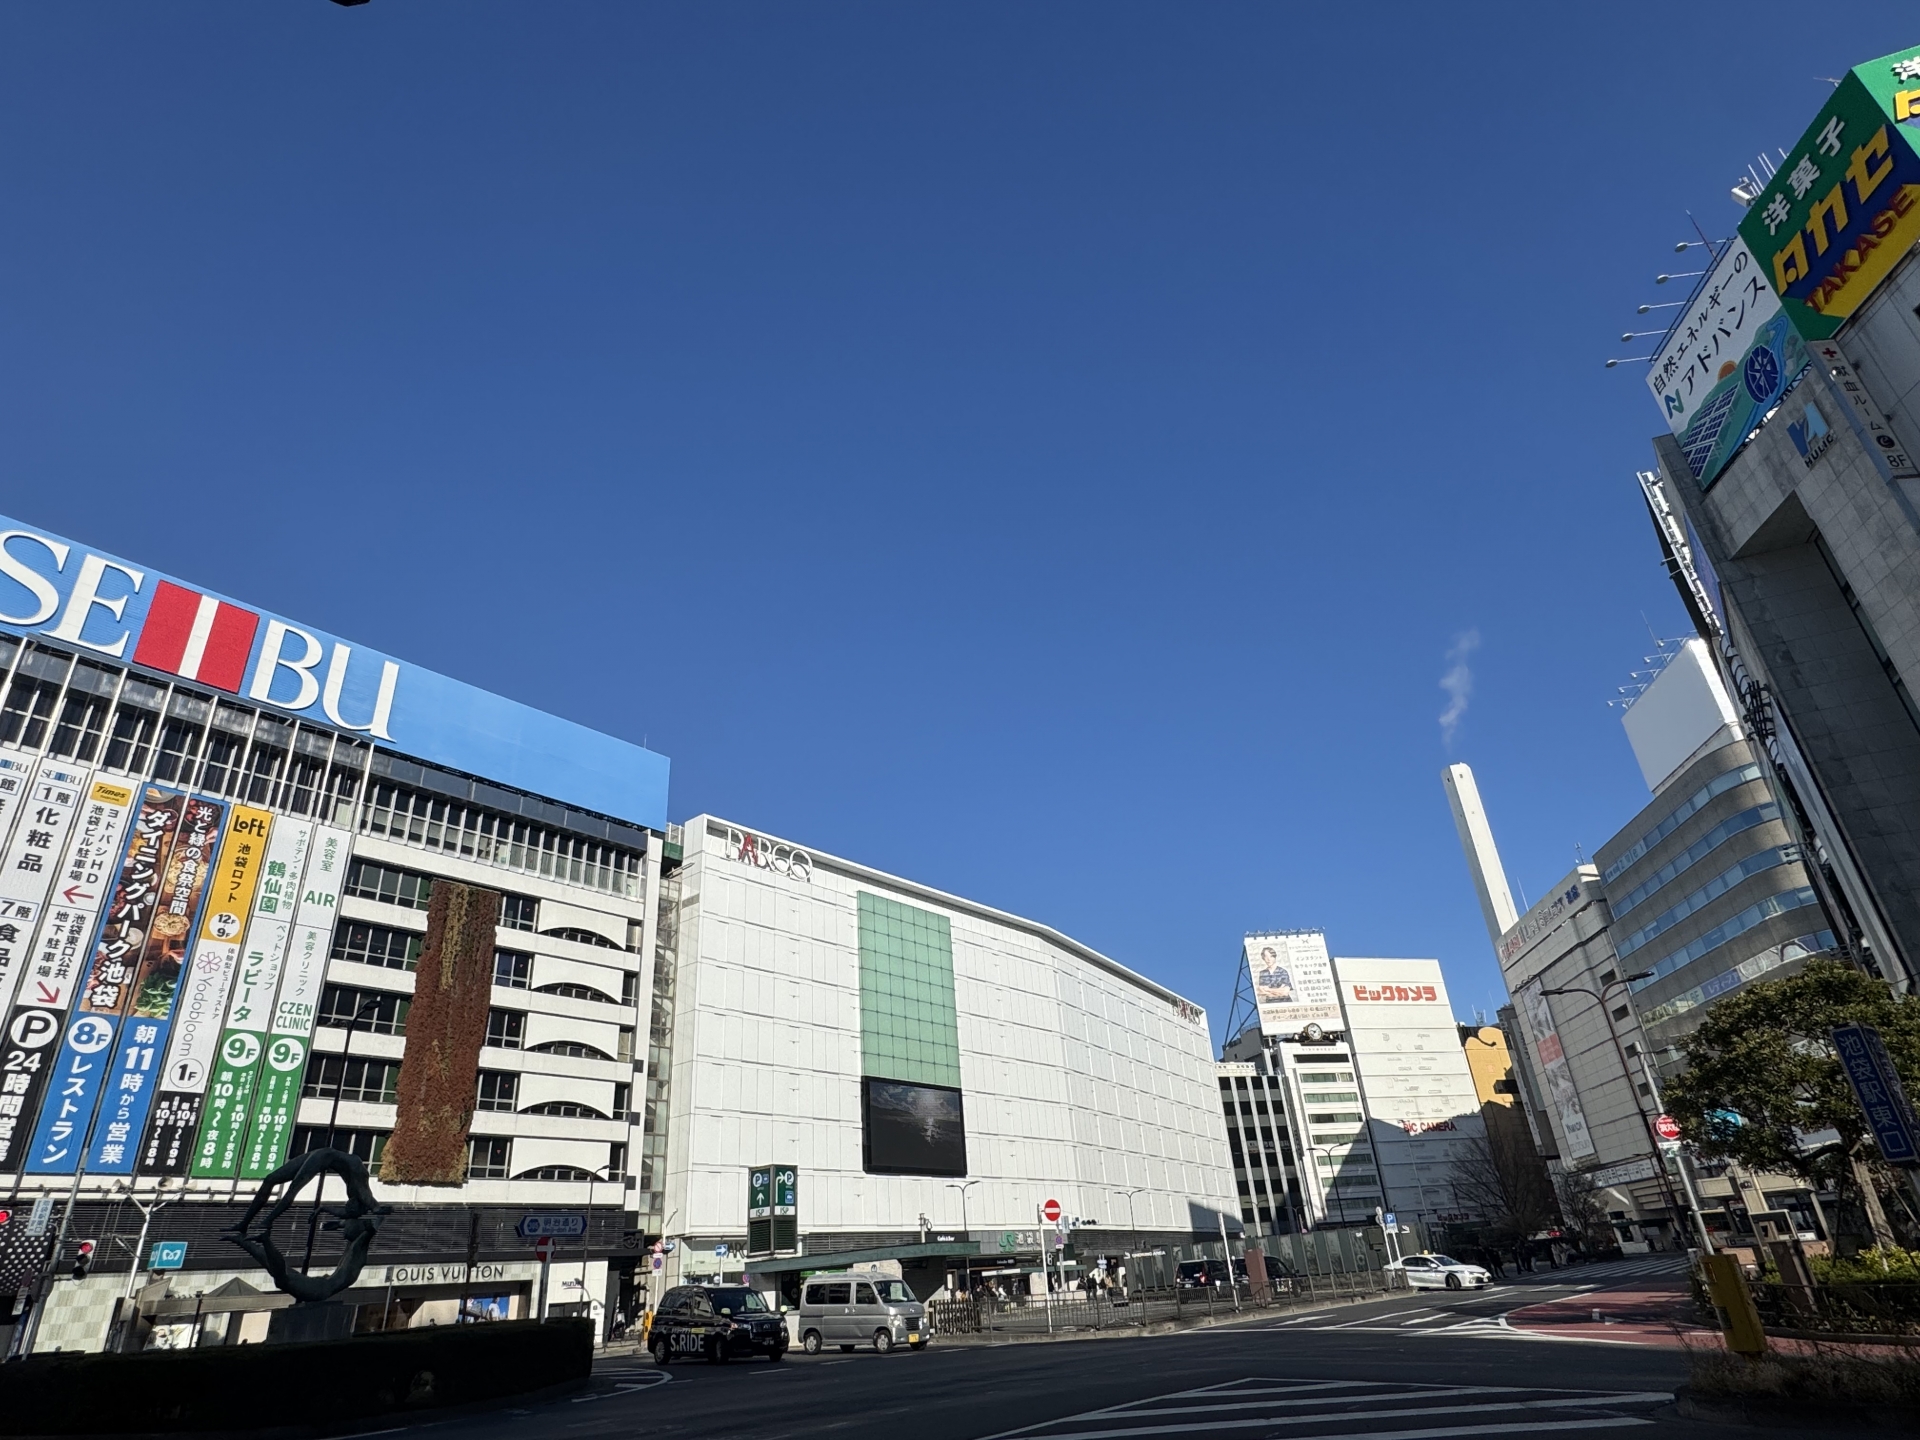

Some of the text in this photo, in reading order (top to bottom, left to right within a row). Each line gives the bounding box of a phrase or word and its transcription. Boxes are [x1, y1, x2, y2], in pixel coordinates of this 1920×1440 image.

[1762, 115, 1845, 236] 洋菓子
[1772, 123, 1894, 296] タカセ
[1805, 184, 1918, 313] TAKASE
[1653, 251, 1748, 396] 自然エネルギーの
[1681, 276, 1767, 395] アドバンス
[1832, 365, 1885, 431] 献血ルーム
[1804, 433, 1835, 468] HULIC
[1887, 454, 1908, 468] 8F
[0, 531, 400, 744] SEIBU
[40, 768, 83, 787] SEIBU
[42, 786, 71, 804] 1階
[96, 786, 127, 798] Times
[17, 806, 61, 873] 化粧品
[68, 804, 104, 882] 池袋ビル駐車場
[86, 808, 120, 884] ヨドバシHD
[320, 837, 338, 873] 美容室
[725, 826, 813, 882] PARCO
[227, 842, 252, 904] 池袋ロフト
[258, 860, 286, 914] 鶴仙園
[303, 890, 336, 908] AIR
[91, 810, 172, 1008] ダイニングパーク池袋
[216, 927, 232, 938] 9F
[218, 913, 237, 925] 12F
[36, 910, 70, 978] 地下駐車場
[54, 913, 86, 980] 池袋東口公共
[263, 924, 287, 990] ペットショップ
[295, 930, 317, 997] 美容クリニック
[233, 951, 264, 1022] ラビータ
[279, 1001, 313, 1017] CZEN
[1353, 985, 1437, 1002] ビックカメラ
[73, 1022, 109, 1046] 8F
[227, 1038, 257, 1059] 9F
[275, 1015, 311, 1031] CLINIC
[178, 1063, 198, 1081] 1F
[272, 1043, 301, 1064] 9F
[42, 1055, 93, 1164] レストラン
[1839, 1035, 1907, 1153] 池袋駅東口
[1403, 1120, 1457, 1133] BIC CAMERA
[441, 1264, 505, 1281] VUITON
[670, 1334, 705, 1352] S.RIDE
